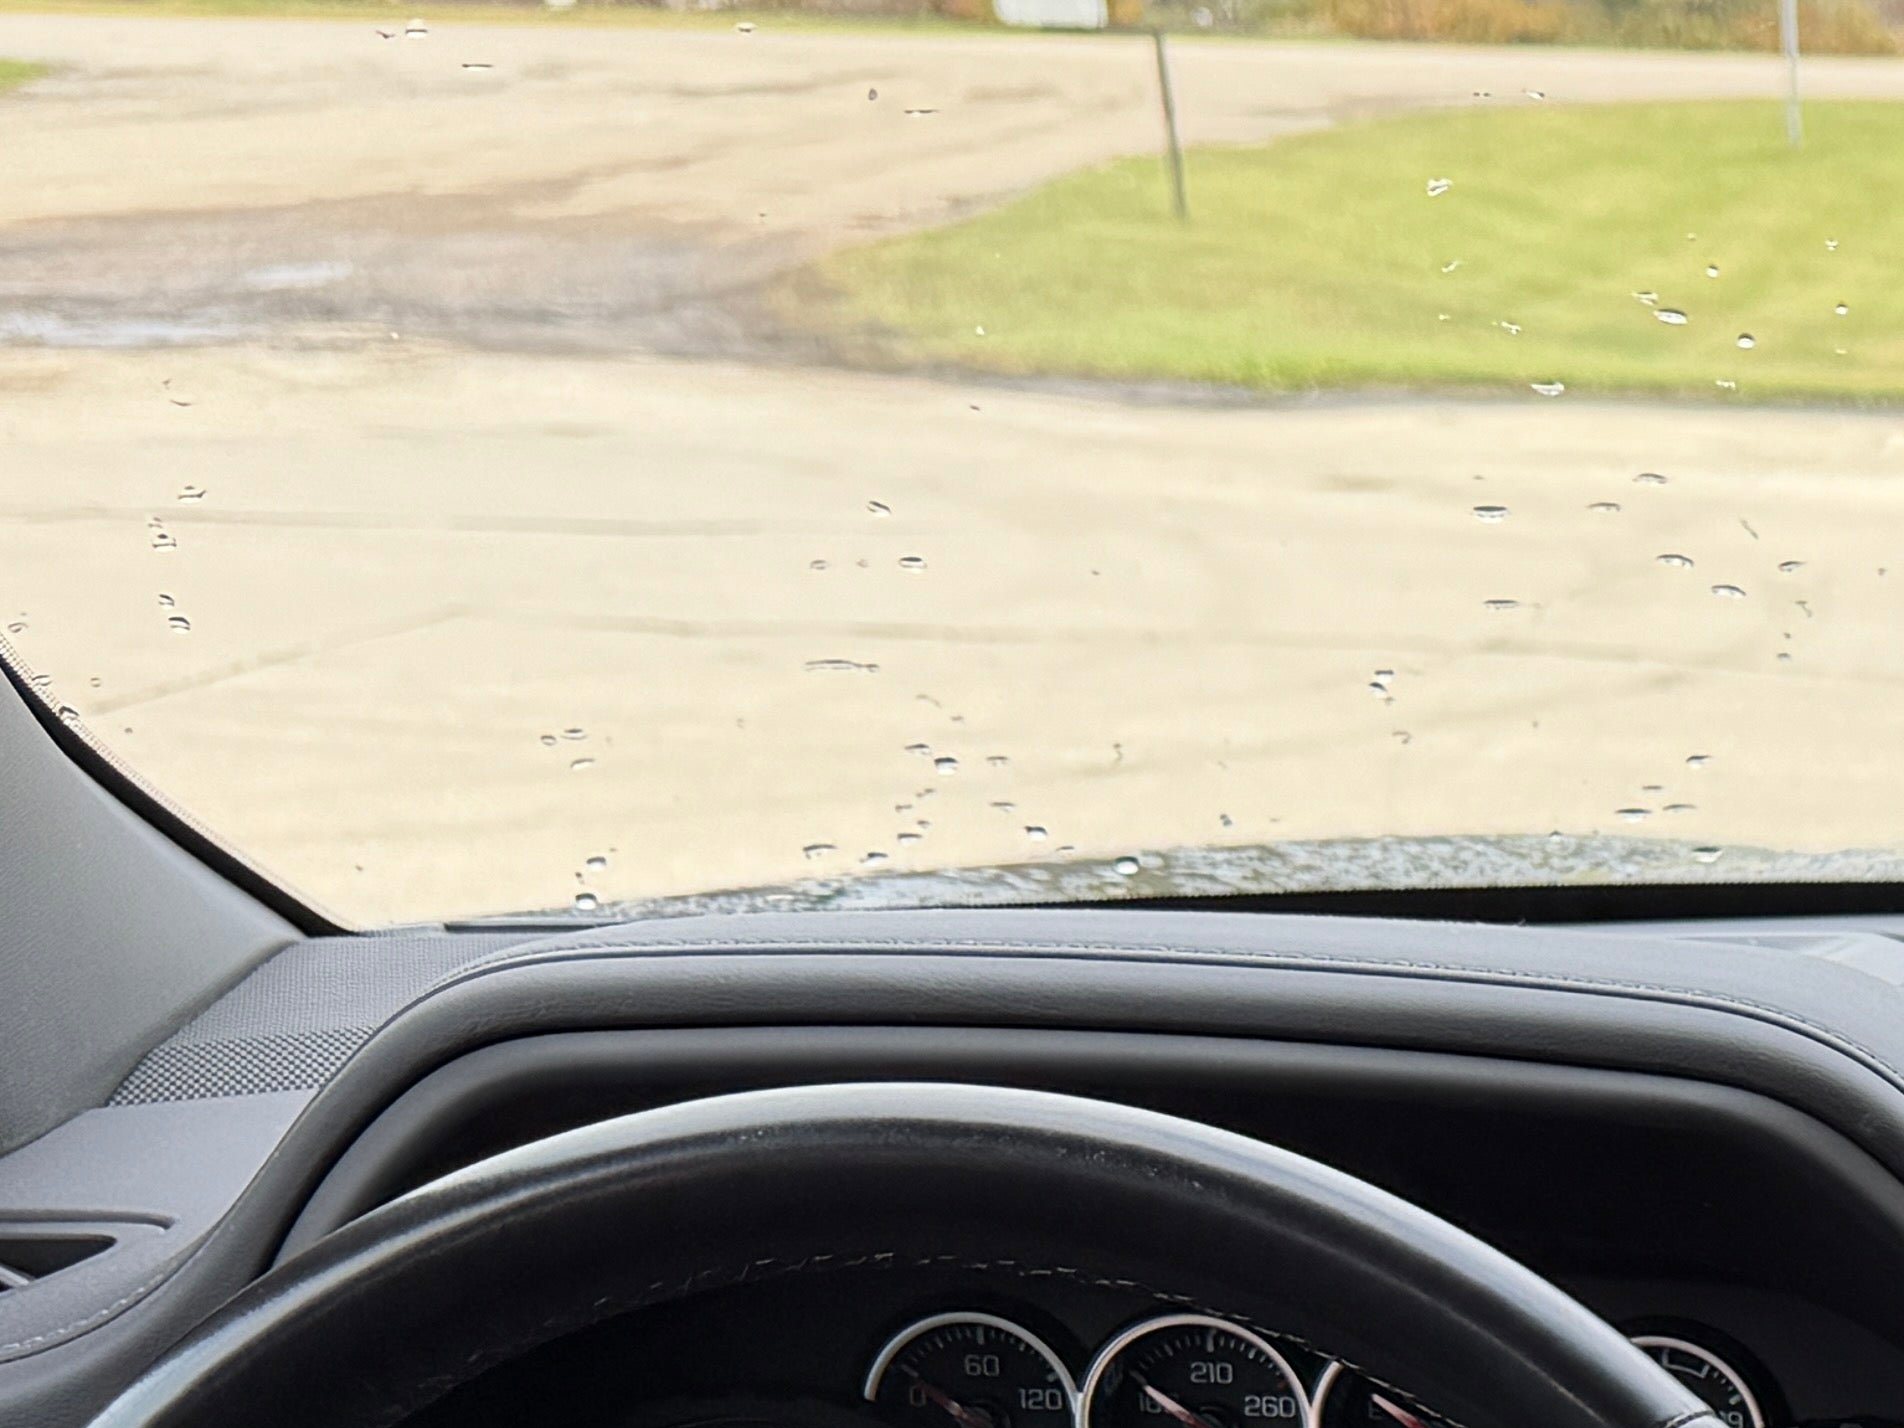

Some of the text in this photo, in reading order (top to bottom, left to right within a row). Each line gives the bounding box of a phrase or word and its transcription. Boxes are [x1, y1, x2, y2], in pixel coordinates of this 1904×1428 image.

[964, 1354, 1001, 1377] 60
[1189, 1361, 1234, 1384] 210
[1019, 1387, 1064, 1410] 120
[1243, 1395, 1297, 1418] 260
